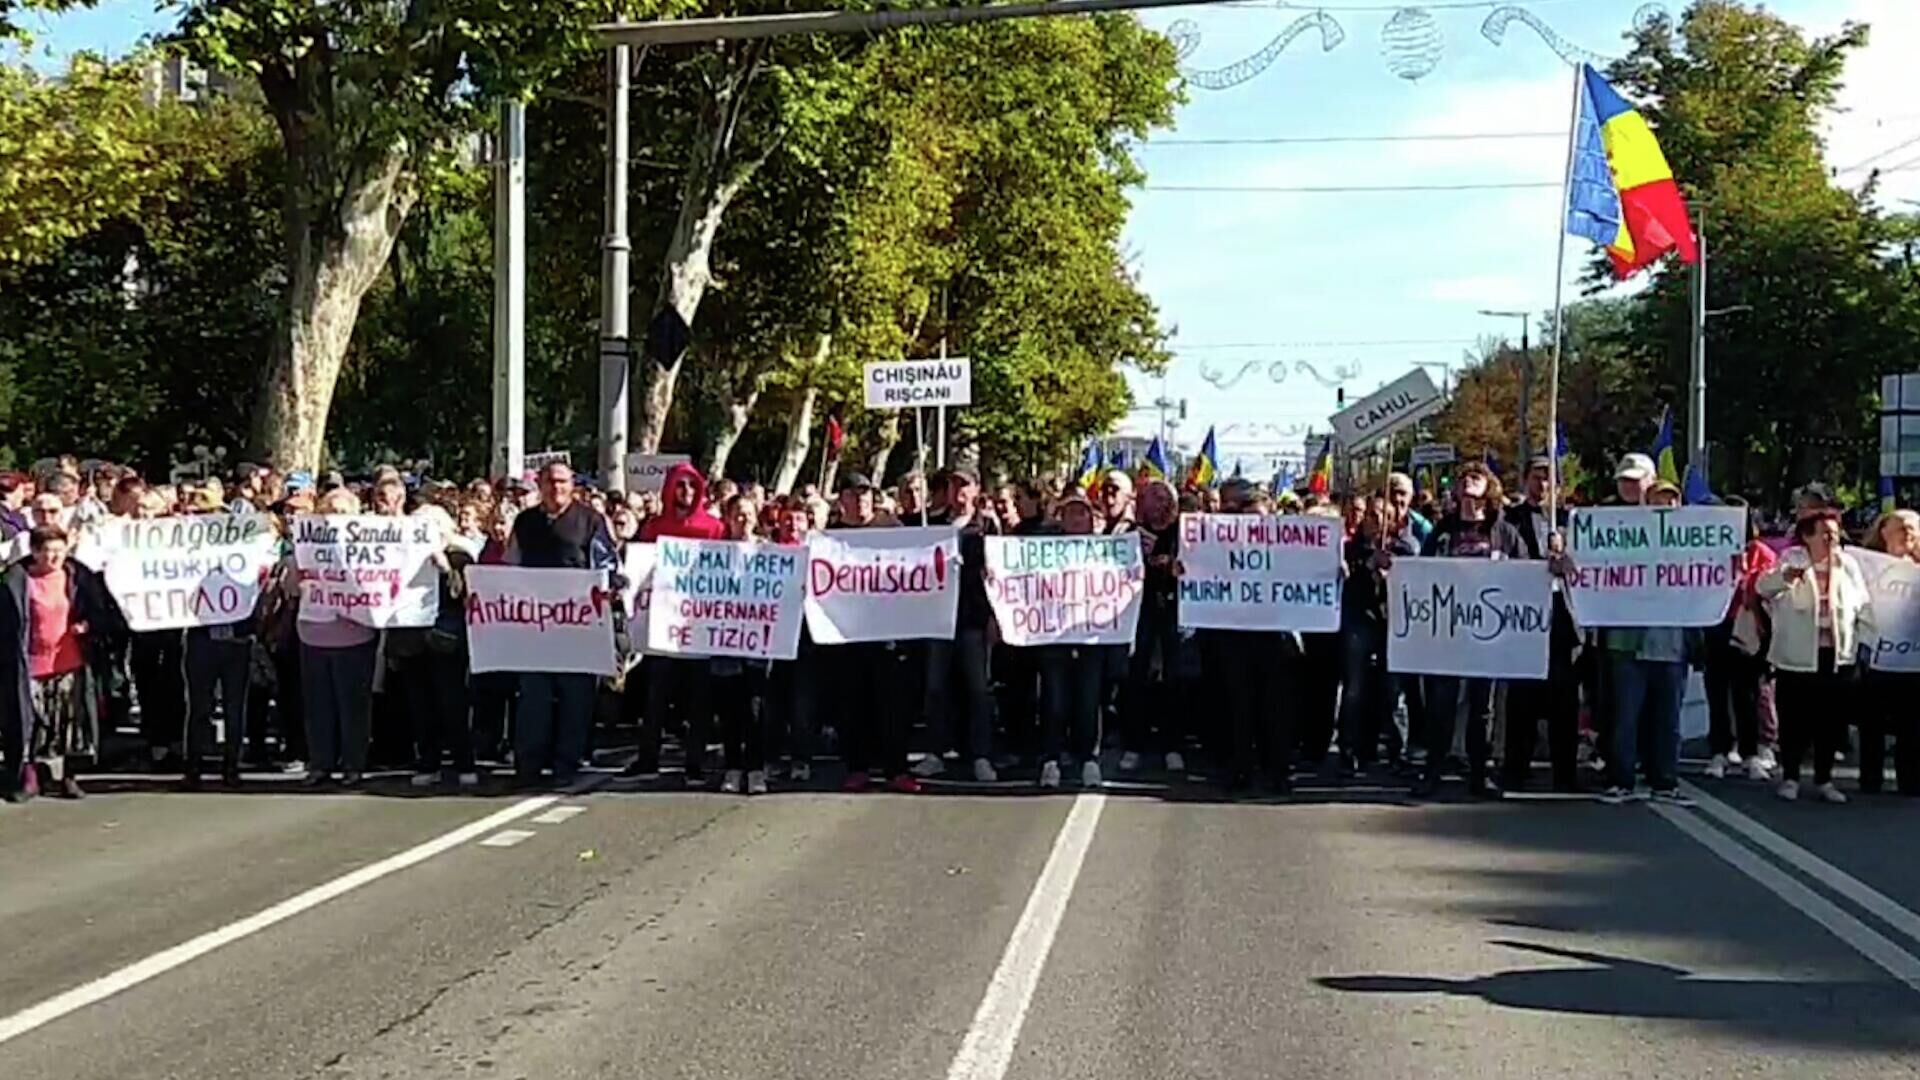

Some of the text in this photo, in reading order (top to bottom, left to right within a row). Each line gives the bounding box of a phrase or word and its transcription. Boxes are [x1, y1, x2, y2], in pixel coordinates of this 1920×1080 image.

[1354, 391, 1419, 431] CAHUL
[345, 521, 403, 543] Sandu
[1185, 517, 1330, 547] EI CU MILIOANE
[345, 545, 386, 564] PAS
[698, 545, 731, 570] MAI
[743, 553, 795, 575] VREM
[1003, 538, 1129, 570] LIBERTATE
[1229, 547, 1271, 571] NOI
[674, 570, 784, 600] NICIUN PIC
[811, 545, 945, 597] Demisia!
[1180, 576, 1233, 603] MURIM
[1240, 582, 1263, 604] DE
[680, 599, 780, 622] GUVERNARE
